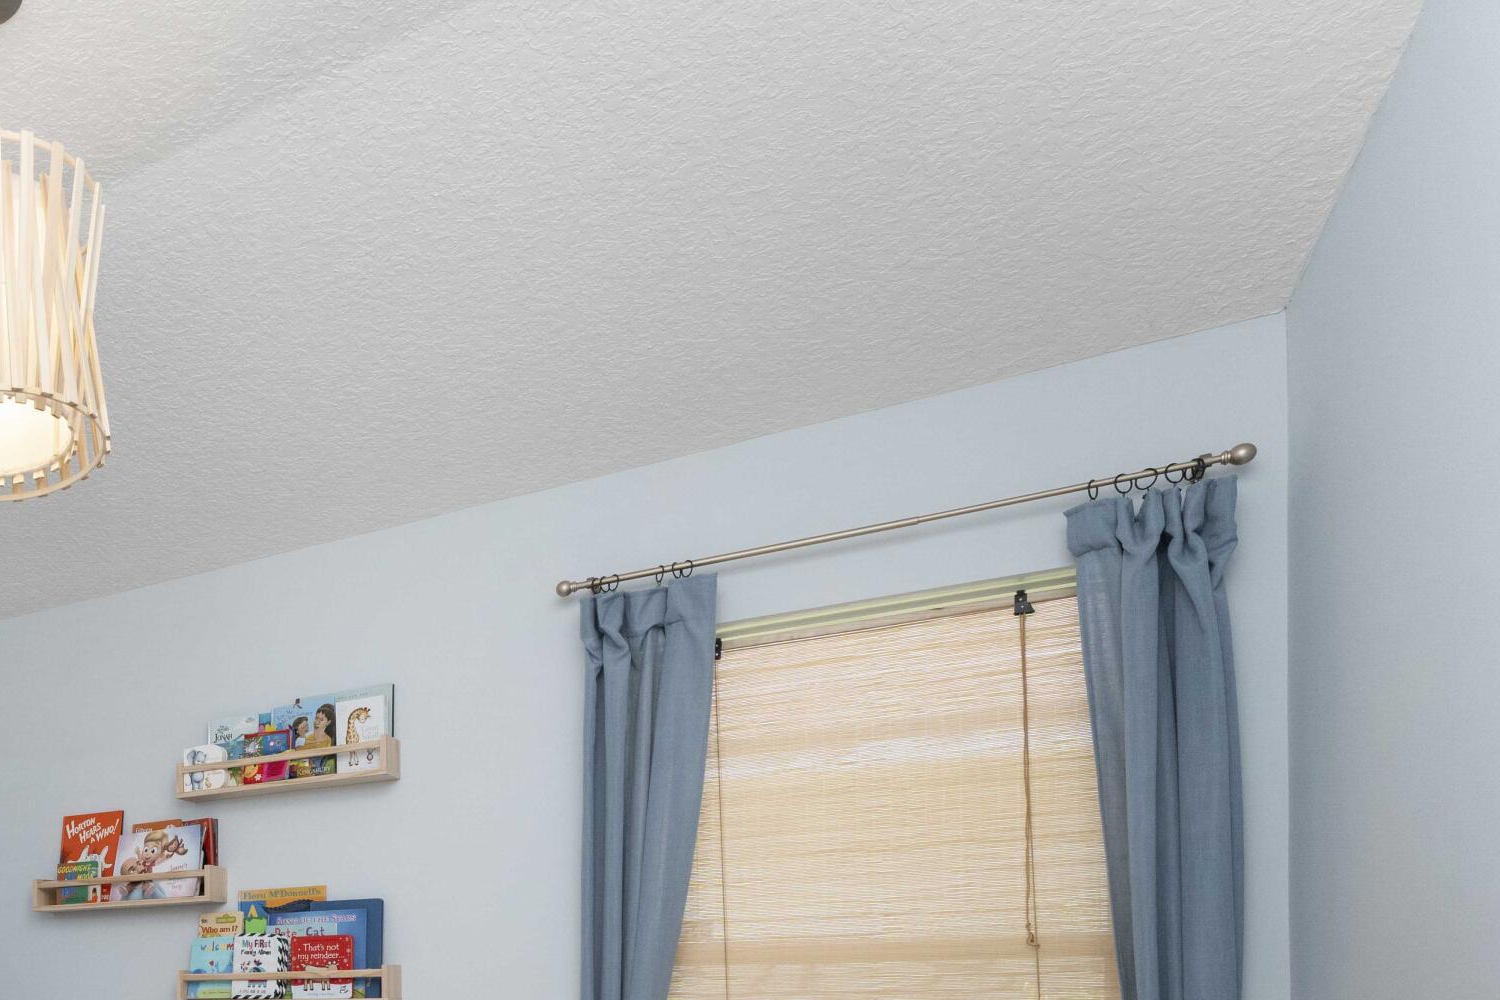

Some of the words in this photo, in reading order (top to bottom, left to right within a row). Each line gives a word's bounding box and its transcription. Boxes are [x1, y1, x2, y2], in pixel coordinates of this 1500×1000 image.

[66, 817, 96, 839] HORTON
[96, 818, 120, 842] WHO!
[79, 823, 102, 844] HEARS
[244, 891, 267, 900] Flora
[201, 926, 218, 934] Who
[305, 926, 325, 936] Cat
[201, 941, 234, 952] welcom
[242, 939, 253, 949] My
[303, 943, 325, 951] That's
[327, 943, 340, 951] not
[297, 952, 309, 960] my
